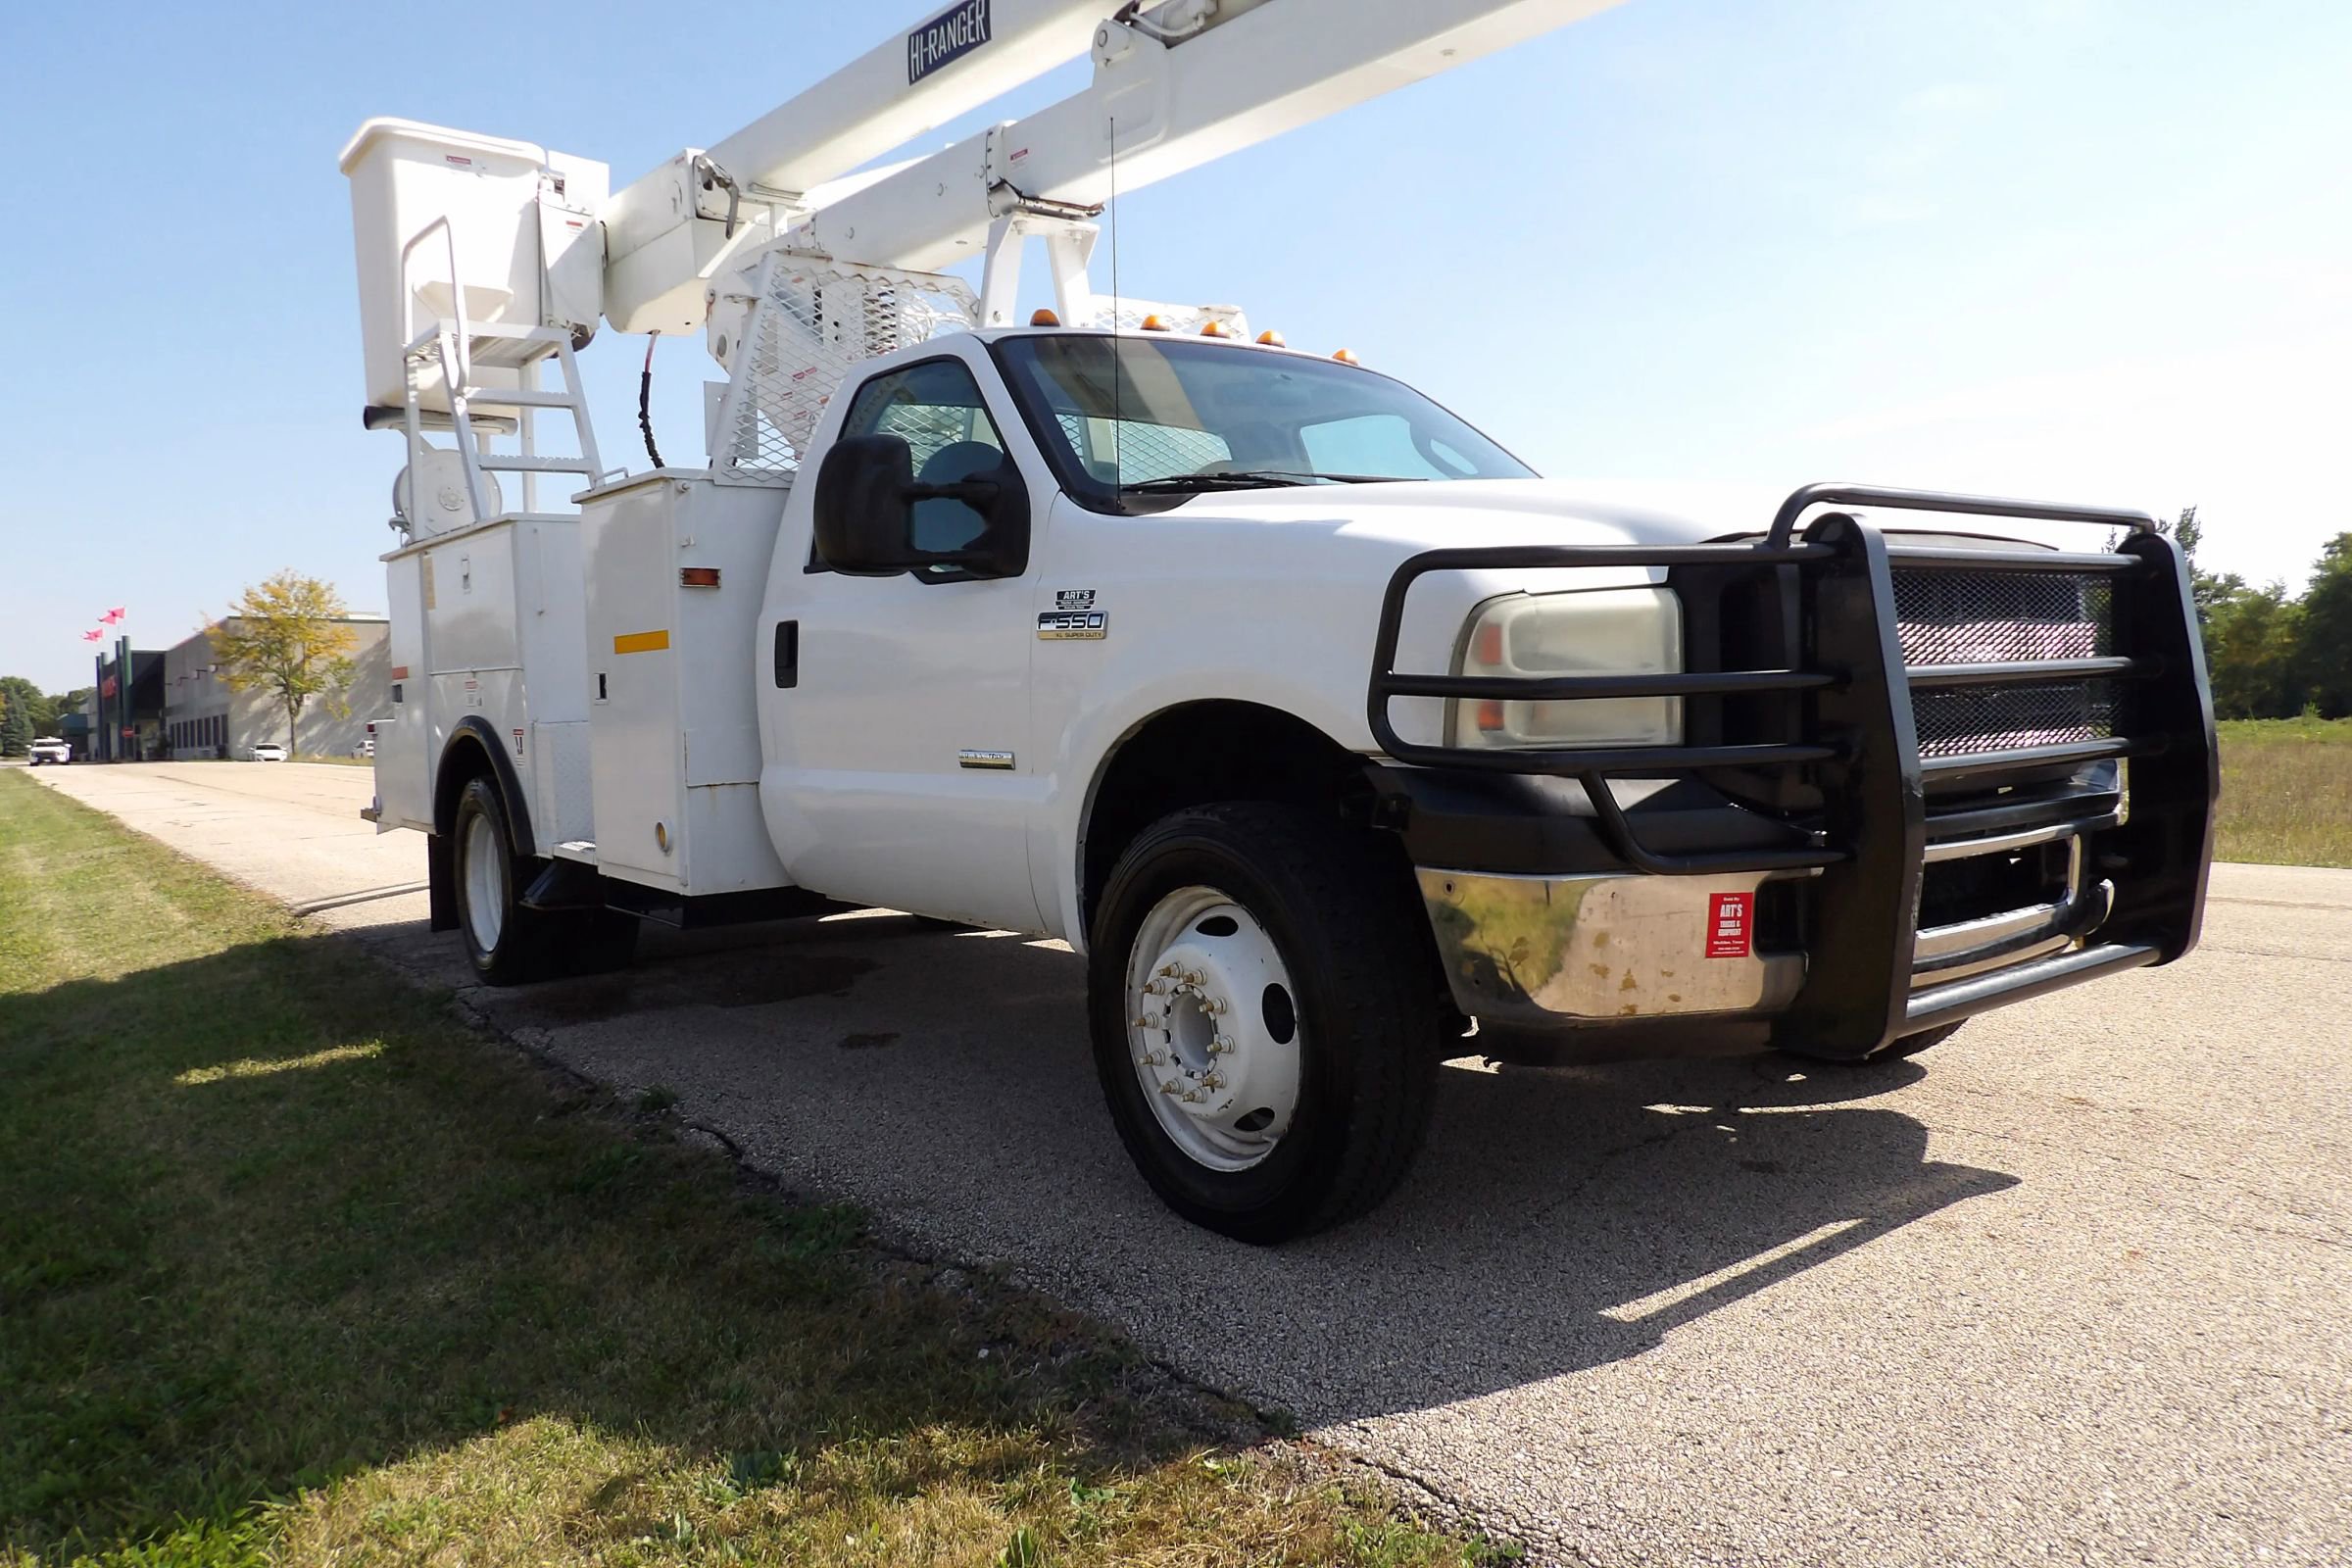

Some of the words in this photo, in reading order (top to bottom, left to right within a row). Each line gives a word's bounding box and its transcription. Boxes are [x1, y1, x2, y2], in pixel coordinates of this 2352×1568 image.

[910, 0, 986, 80] HI-RANGER
[1063, 590, 1090, 600] ART'S
[1720, 904, 1742, 918] ART'S
